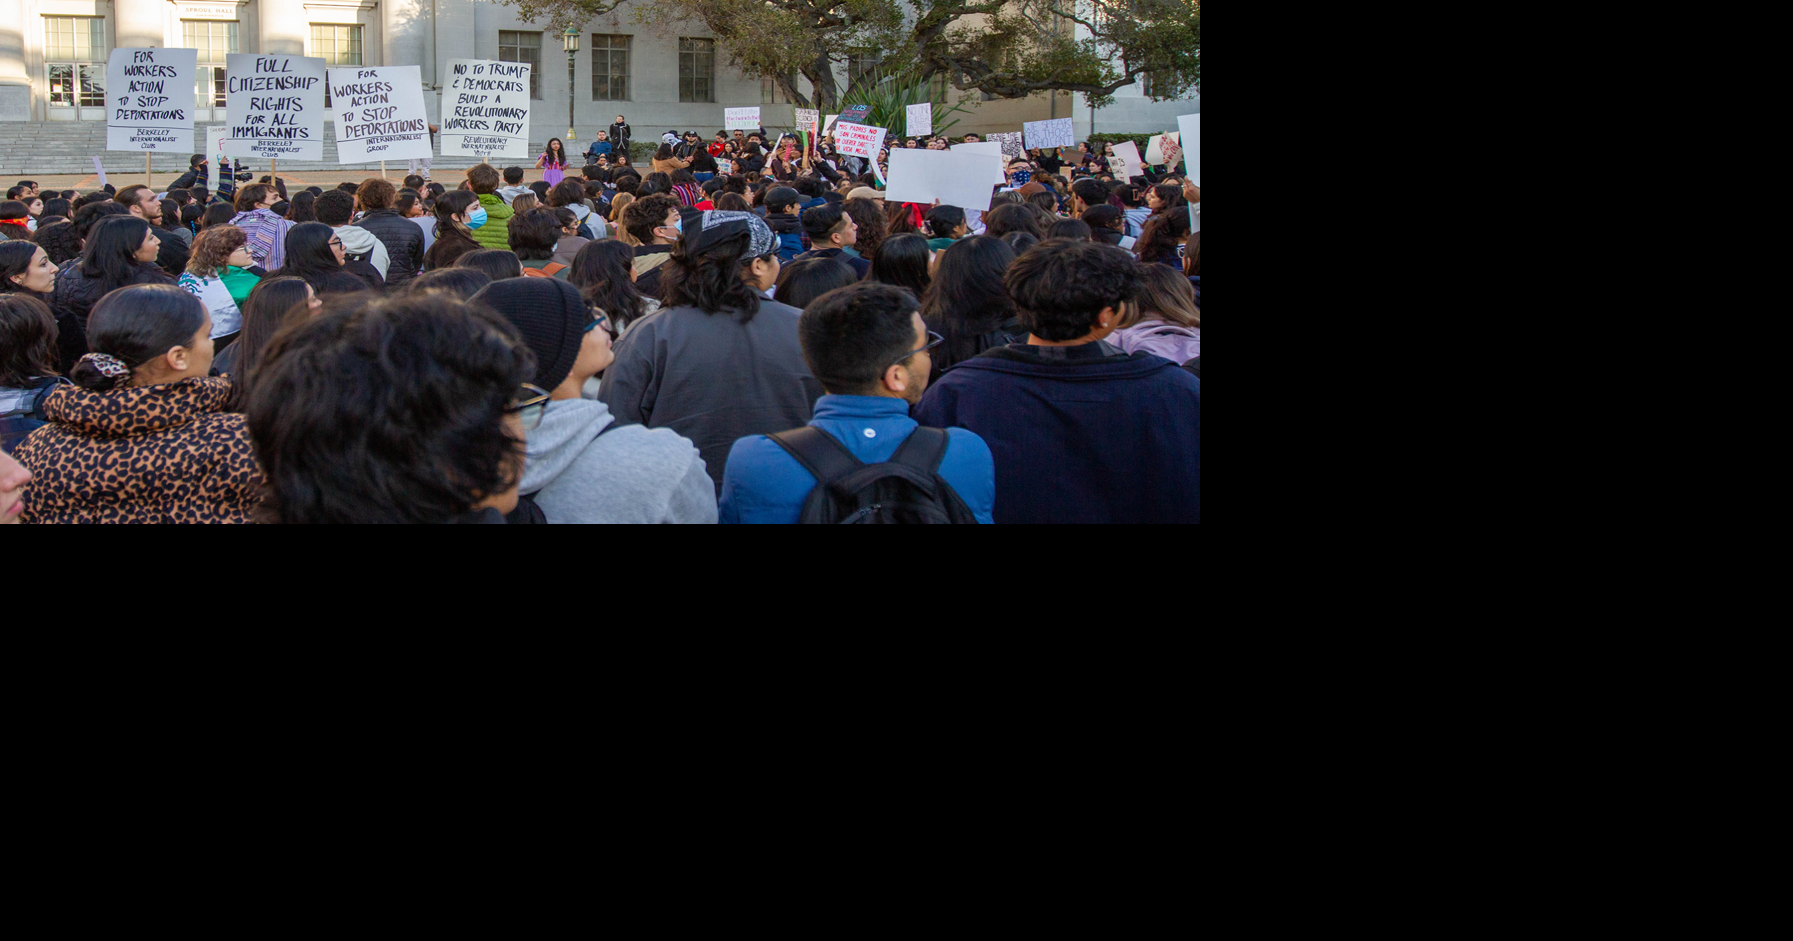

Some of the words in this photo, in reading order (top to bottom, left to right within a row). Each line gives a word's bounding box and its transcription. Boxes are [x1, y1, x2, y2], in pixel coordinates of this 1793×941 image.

[134, 51, 154, 63] FOR
[124, 65, 177, 78] WORKERS
[256, 57, 293, 73] FULL
[453, 64, 468, 75] NO
[473, 64, 484, 75] TO
[488, 63, 530, 79] TRUMP
[358, 69, 378, 79] FOR
[128, 80, 165, 94] ACTION
[229, 76, 319, 94] CITIZENSHIP
[333, 81, 393, 98] WORKERS
[463, 77, 524, 92] DEMOCRATS
[118, 96, 129, 106] TO
[137, 95, 169, 108] STOP
[250, 96, 303, 112] RIGHTS
[351, 92, 389, 108] ACTION
[457, 93, 488, 104] BUILD
[495, 94, 501, 103] A
[116, 109, 185, 120] DEPORTATIONS
[342, 112, 354, 122] TO
[361, 105, 398, 122] STOP
[454, 105, 528, 120] REVOLUTIONARY
[245, 114, 266, 125] FOR
[271, 113, 299, 127] ALL
[444, 118, 490, 130] WORKERS
[493, 120, 524, 135] PARTY
[1041, 118, 1071, 129] SPEAK
[137, 128, 170, 136] BERKELEY
[232, 126, 309, 139] IMMIGRANTS
[345, 119, 425, 139] DEPORTATIONS
[849, 125, 867, 134] PADRES
[1042, 127, 1071, 139] THOSE
[366, 134, 422, 145] INTERNATIONALIST
[463, 135, 508, 145] REVOLUTIONARY
[850, 132, 877, 143] CRIMINALES
[1027, 137, 1049, 149] WHO
[366, 145, 389, 153] GROUP
[843, 145, 853, 153] VIDA
